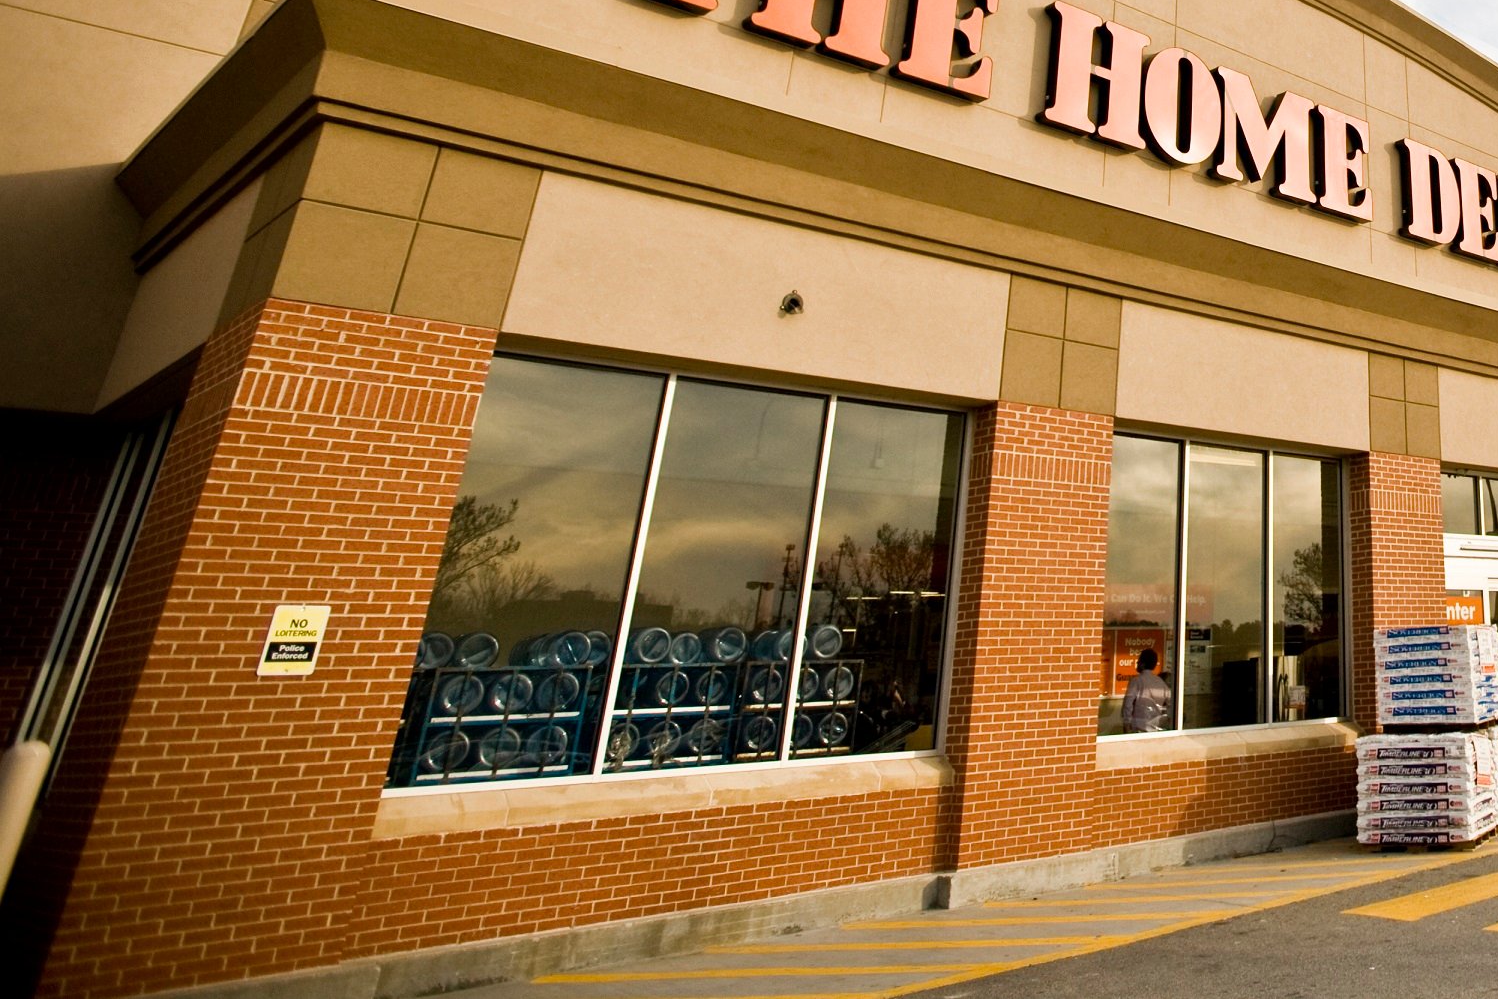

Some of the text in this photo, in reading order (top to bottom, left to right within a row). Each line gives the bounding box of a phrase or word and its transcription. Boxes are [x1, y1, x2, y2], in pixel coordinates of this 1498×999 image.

[1038, 0, 1373, 223] HOME
[1446, 602, 1476, 620] nter
[289, 618, 309, 629] NO
[279, 644, 305, 652] Police
[1125, 638, 1156, 649] Nobody
[271, 652, 309, 660] Enforced
[1119, 658, 1135, 666] our
